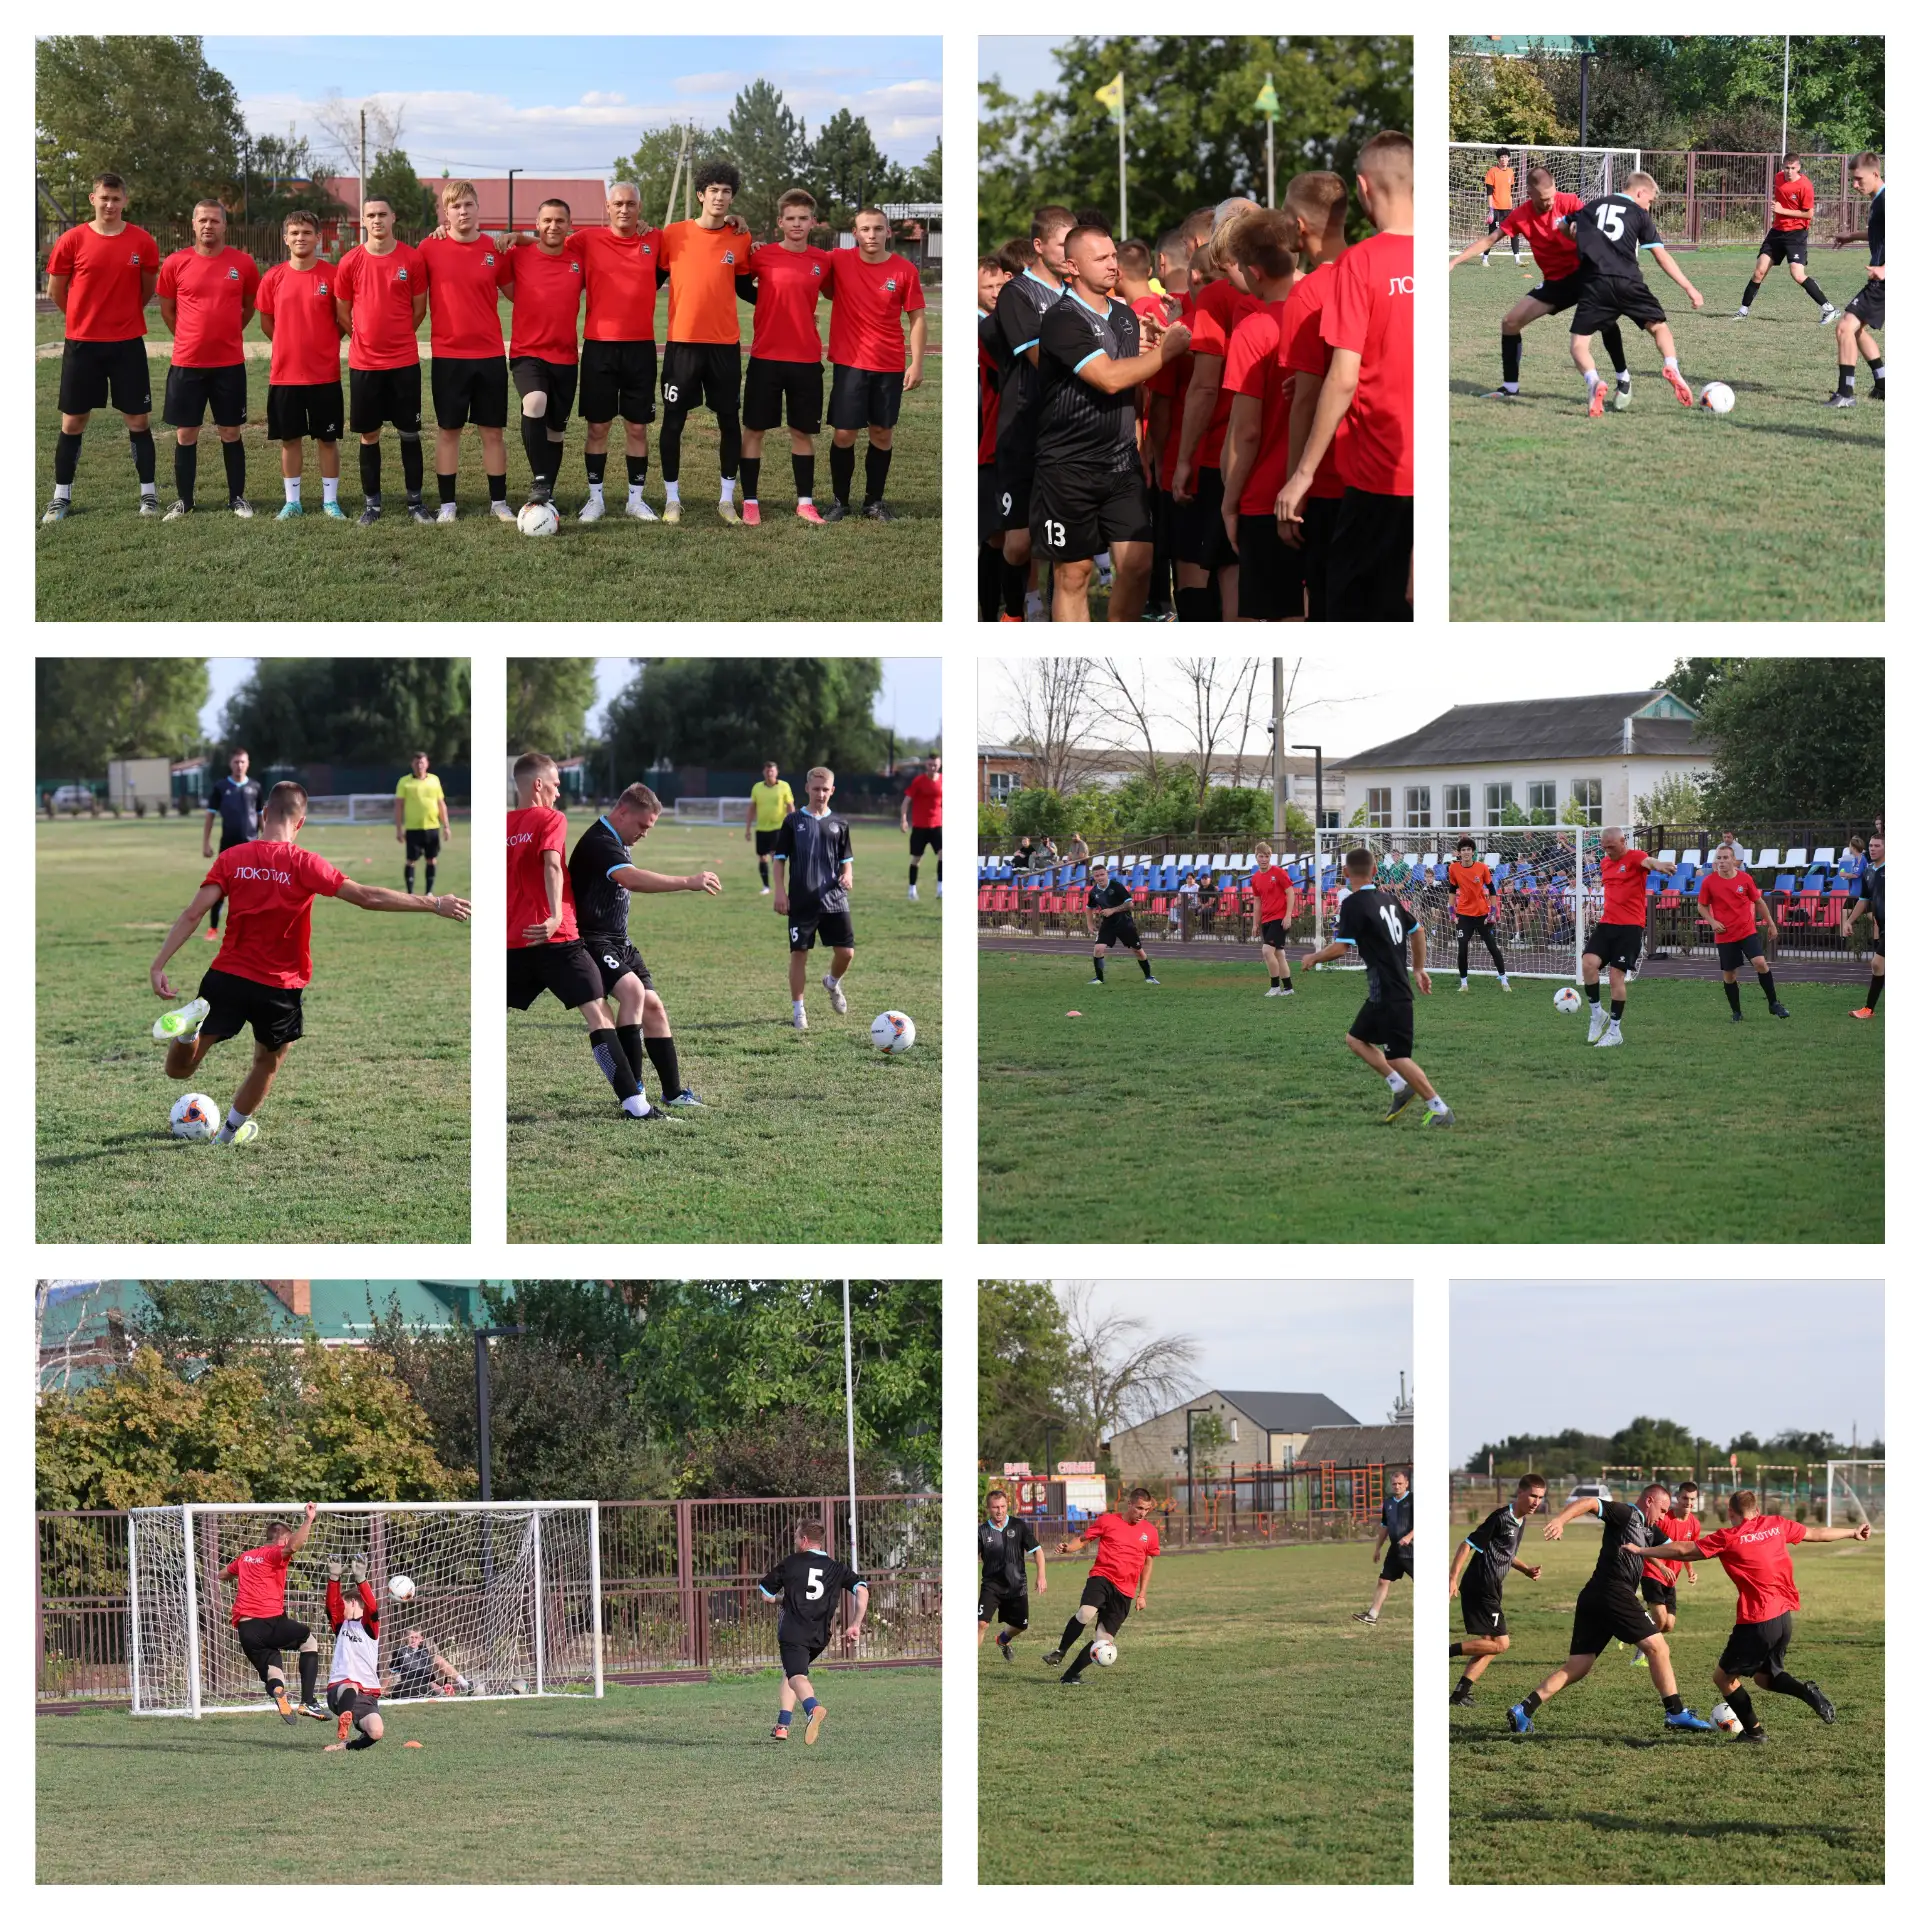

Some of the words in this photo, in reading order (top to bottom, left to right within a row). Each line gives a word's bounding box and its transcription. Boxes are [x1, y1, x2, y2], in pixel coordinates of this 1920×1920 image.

[1595, 203, 1627, 242] 15
[664, 382, 679, 403] 16
[1002, 492, 1012, 516] 9
[1044, 519, 1066, 547] 13
[1379, 904, 1403, 946] 16
[603, 954, 620, 969] 8
[1740, 1526, 1781, 1545] ЛОКОТИХ
[805, 1567, 825, 1601] 5
[1491, 1612, 1500, 1627] 7
